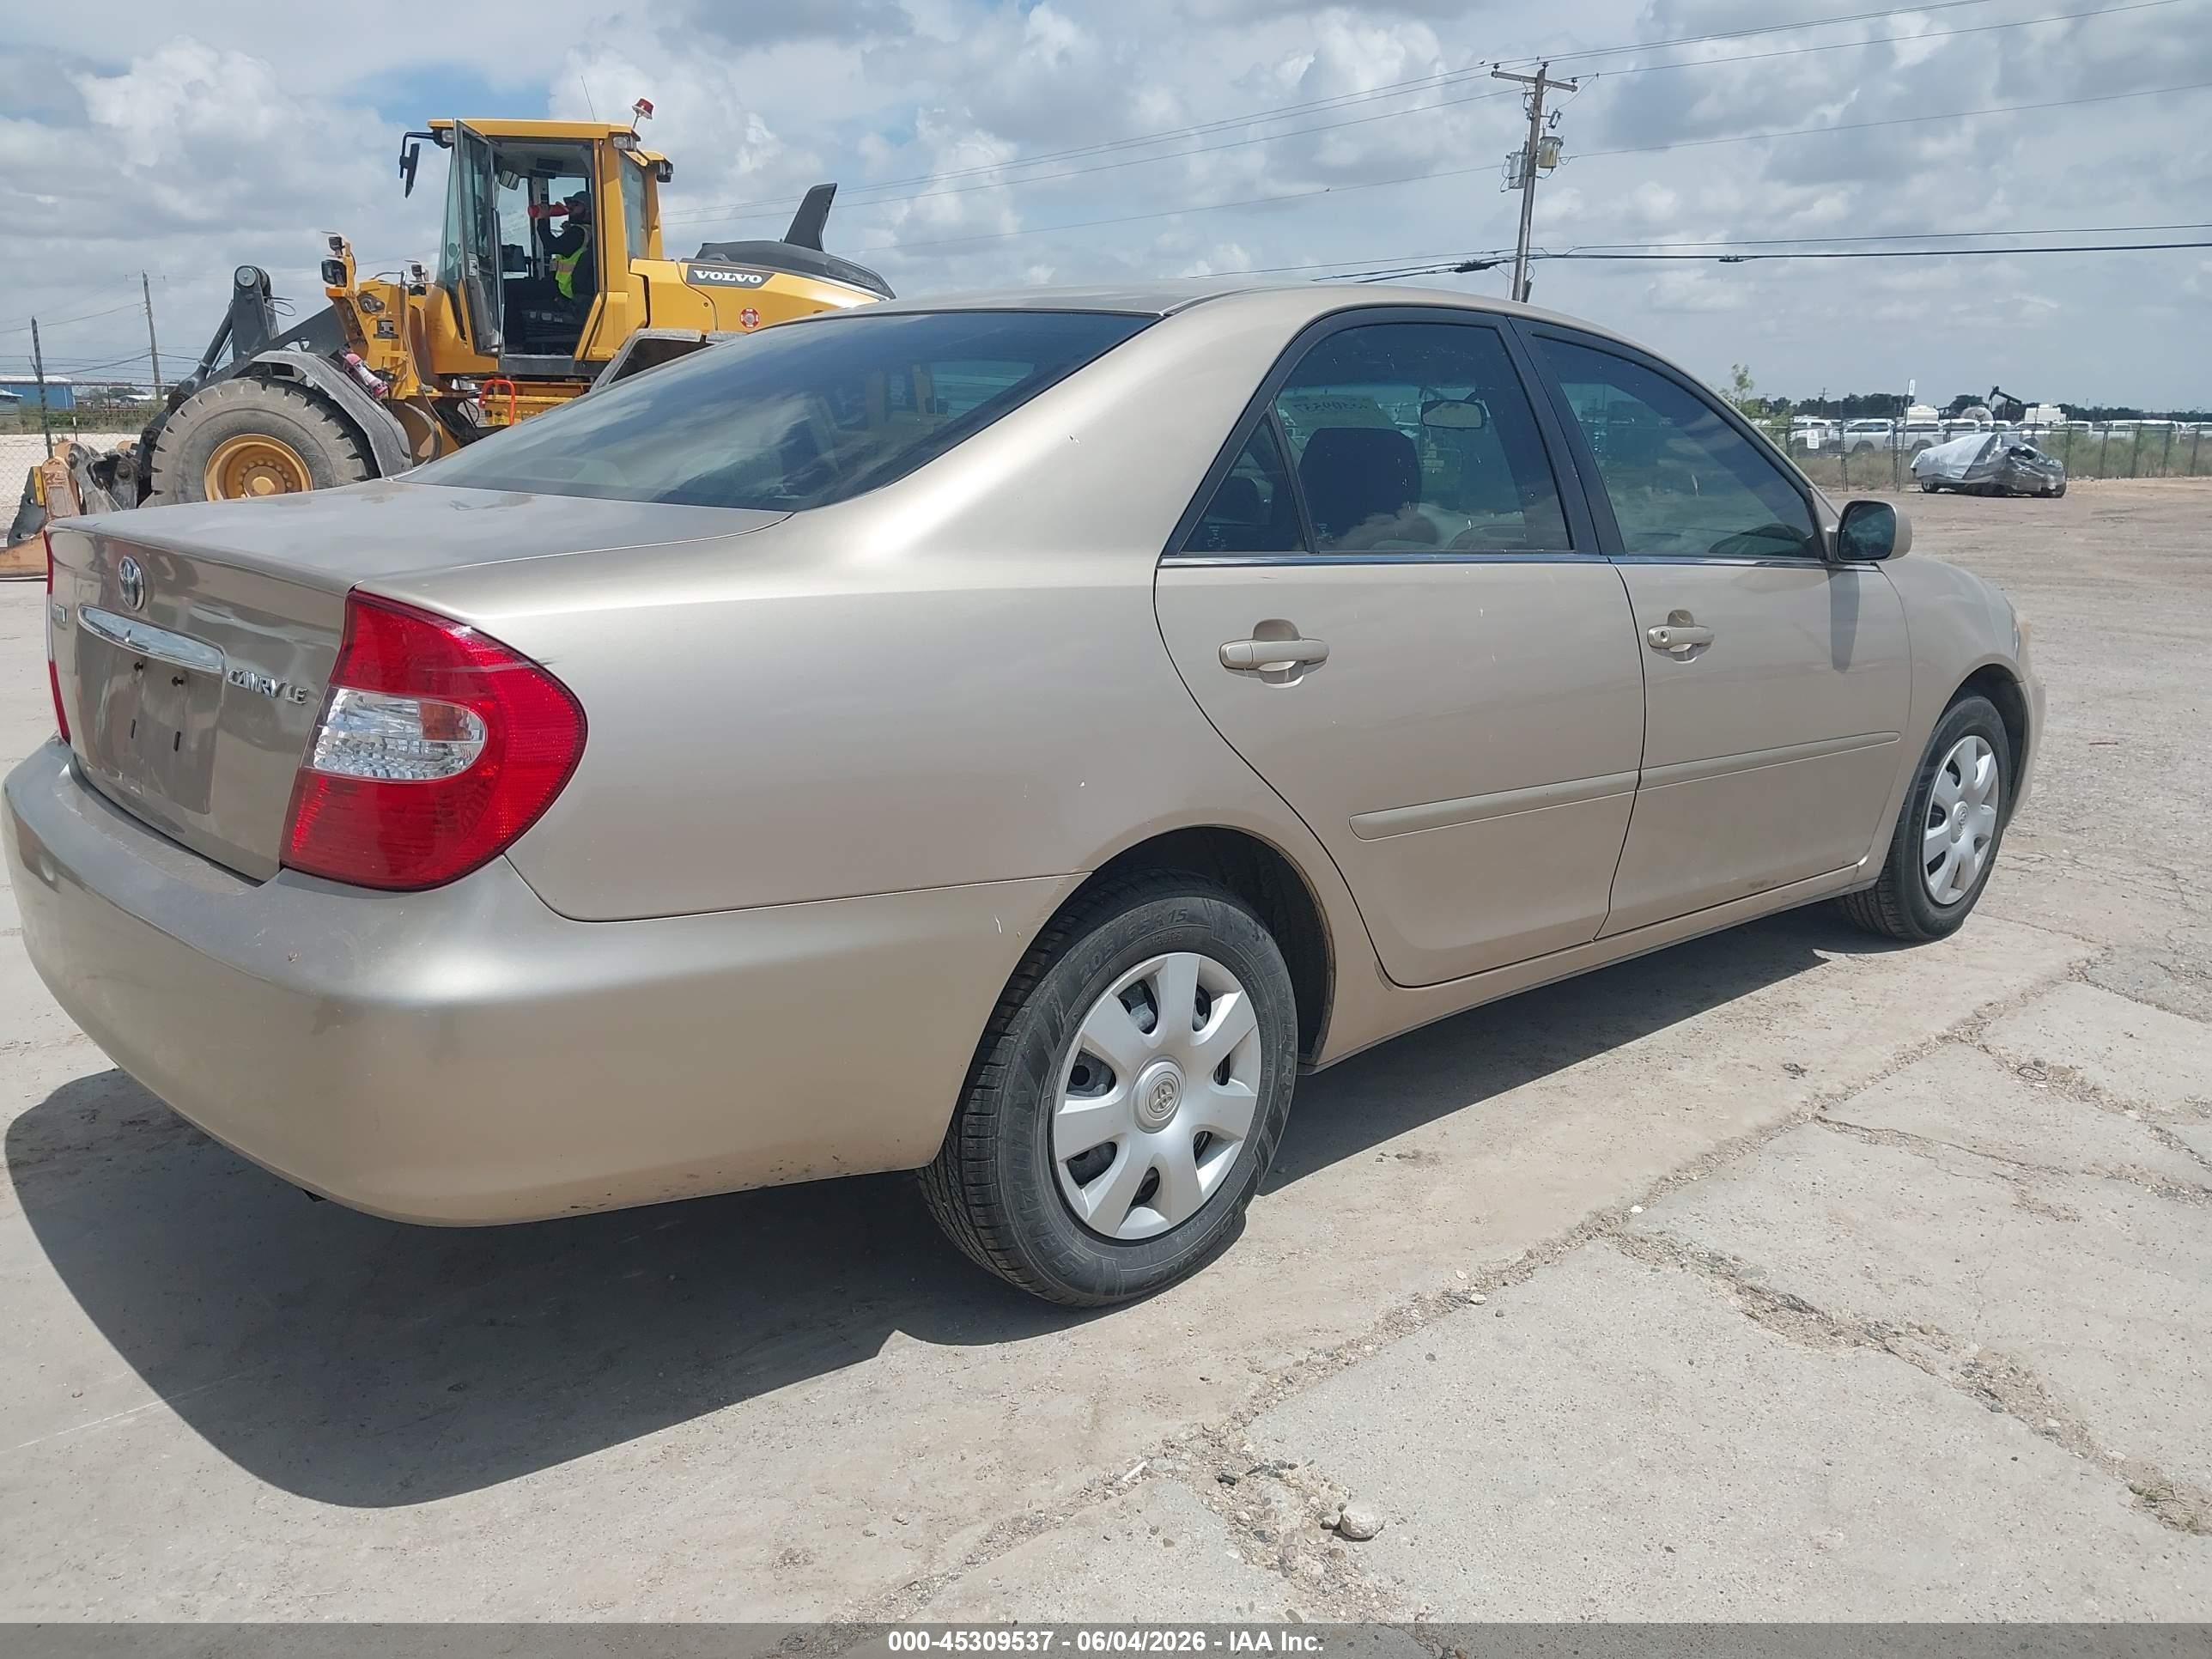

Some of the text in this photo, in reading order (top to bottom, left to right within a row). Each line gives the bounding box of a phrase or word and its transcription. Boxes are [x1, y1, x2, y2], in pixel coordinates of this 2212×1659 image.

[694, 270, 763, 284] VOLVO
[228, 669, 309, 705] CAMRY LE
